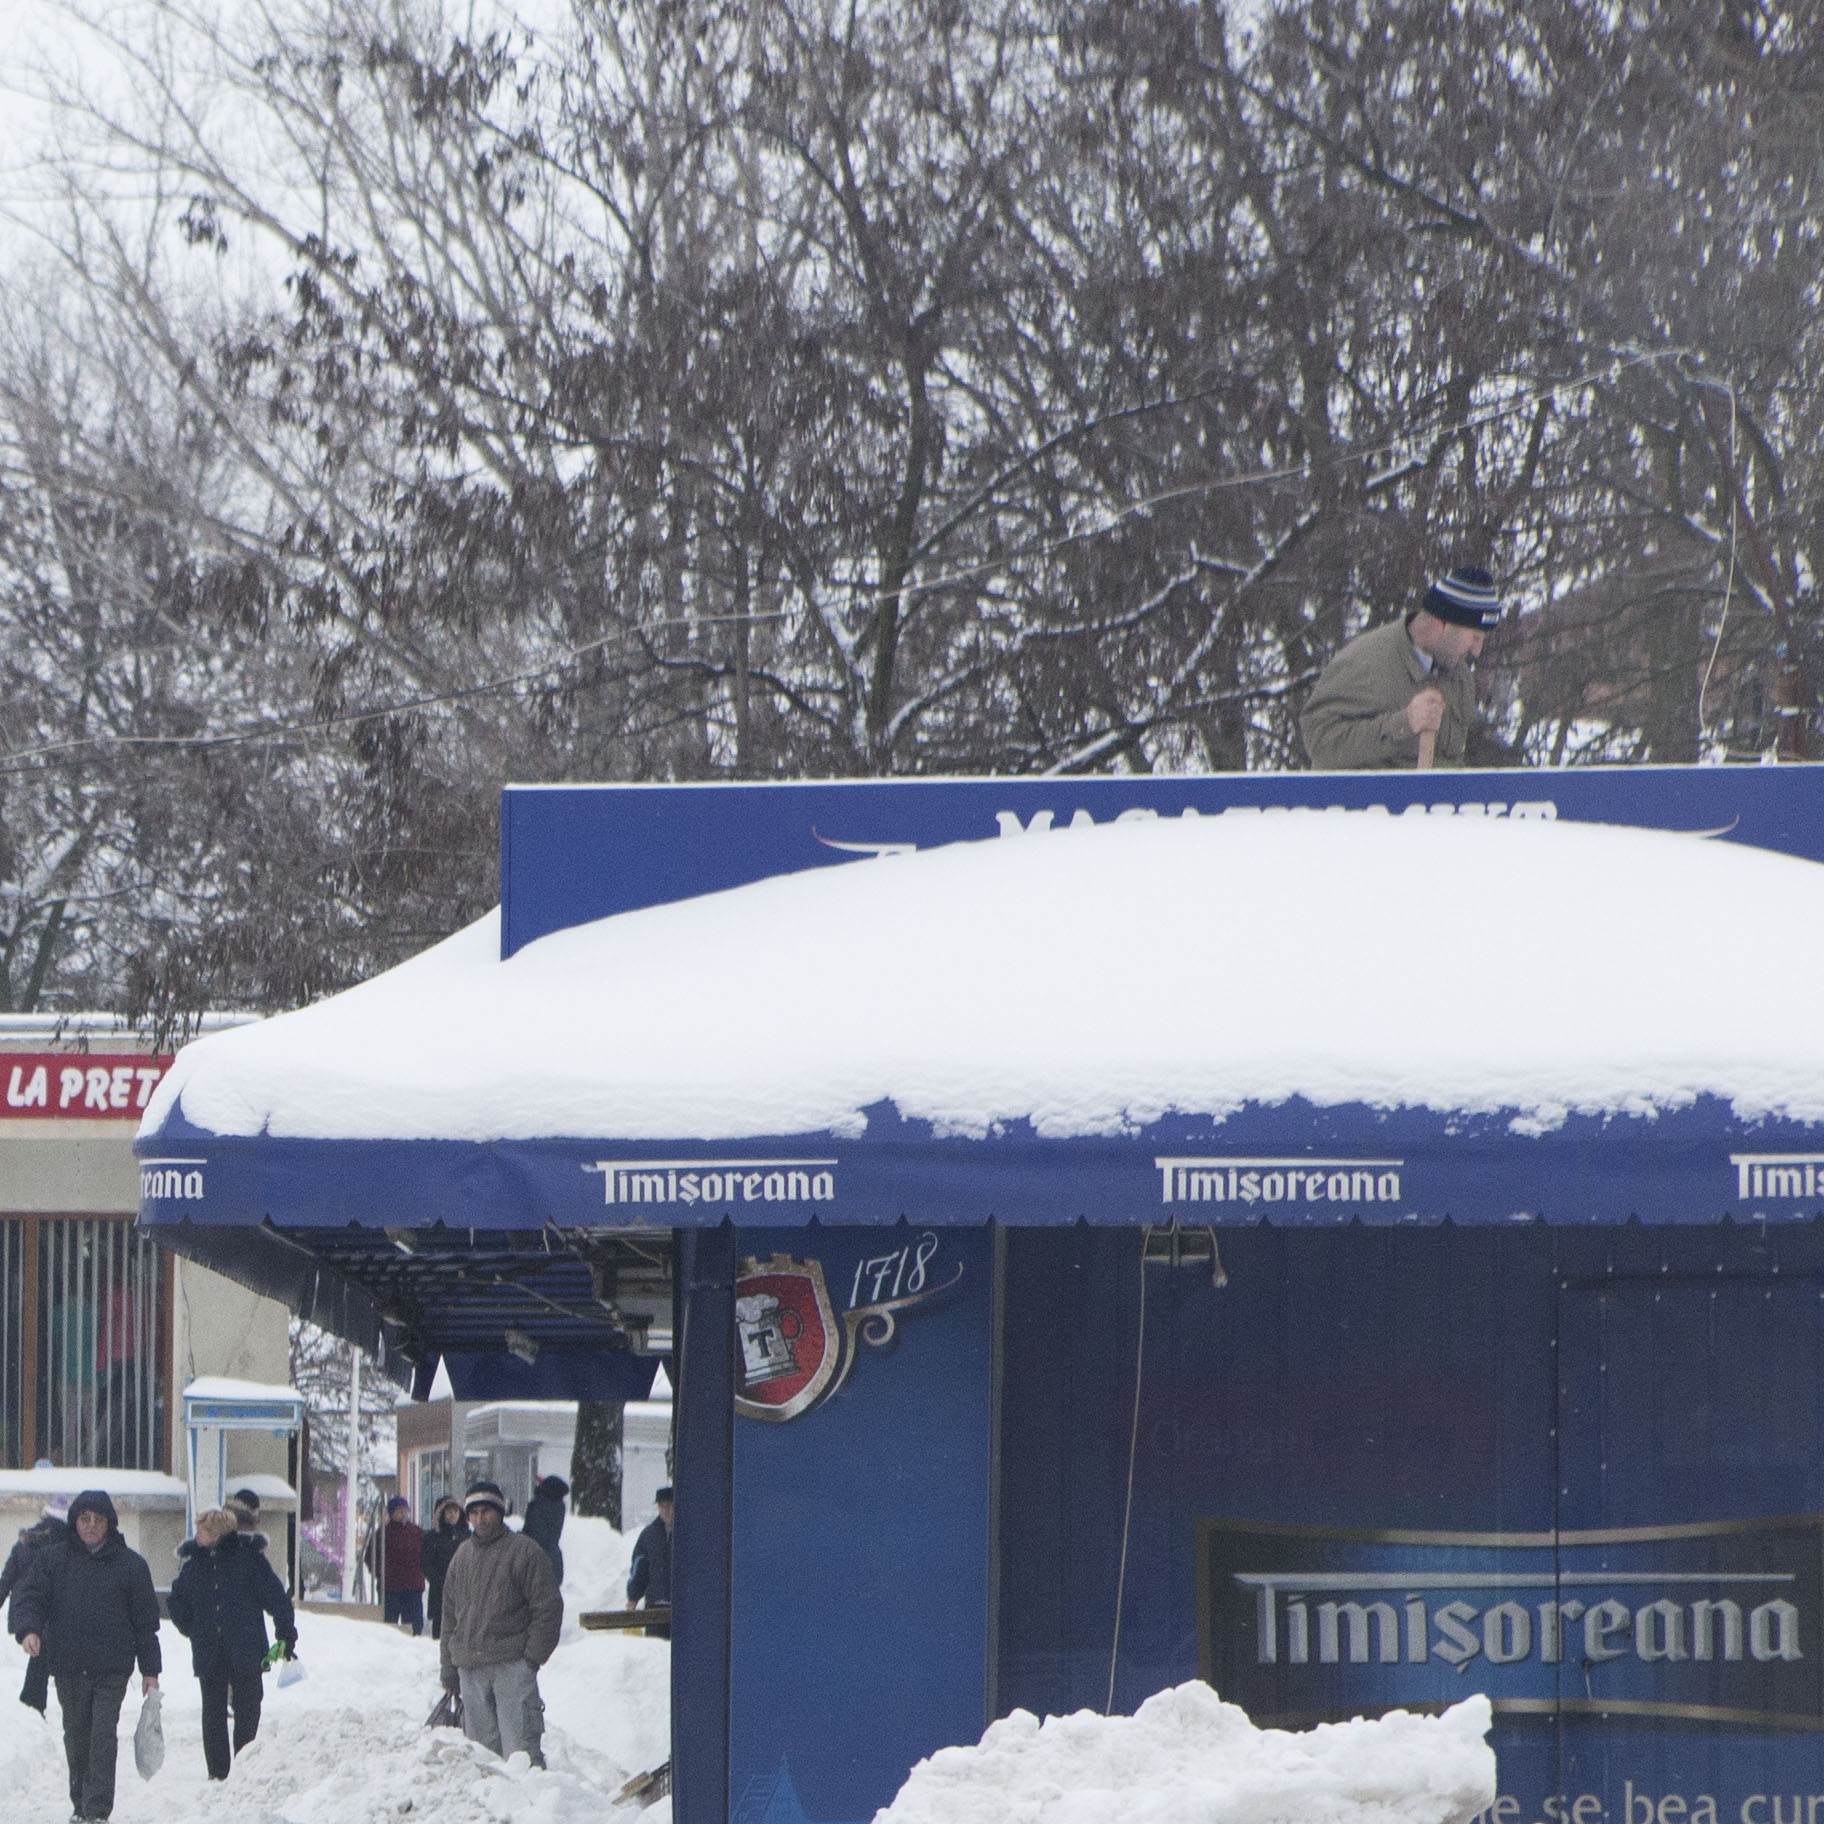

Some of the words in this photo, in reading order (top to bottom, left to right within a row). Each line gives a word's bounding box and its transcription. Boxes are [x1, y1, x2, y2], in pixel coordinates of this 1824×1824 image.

[6, 1067, 48, 1107] LA
[590, 1159, 838, 1206] Timișoreana
[1155, 1157, 1405, 1206] Timișoreana
[849, 1231, 938, 1308] 1718
[1233, 1572, 1803, 1675] Timișoreana
